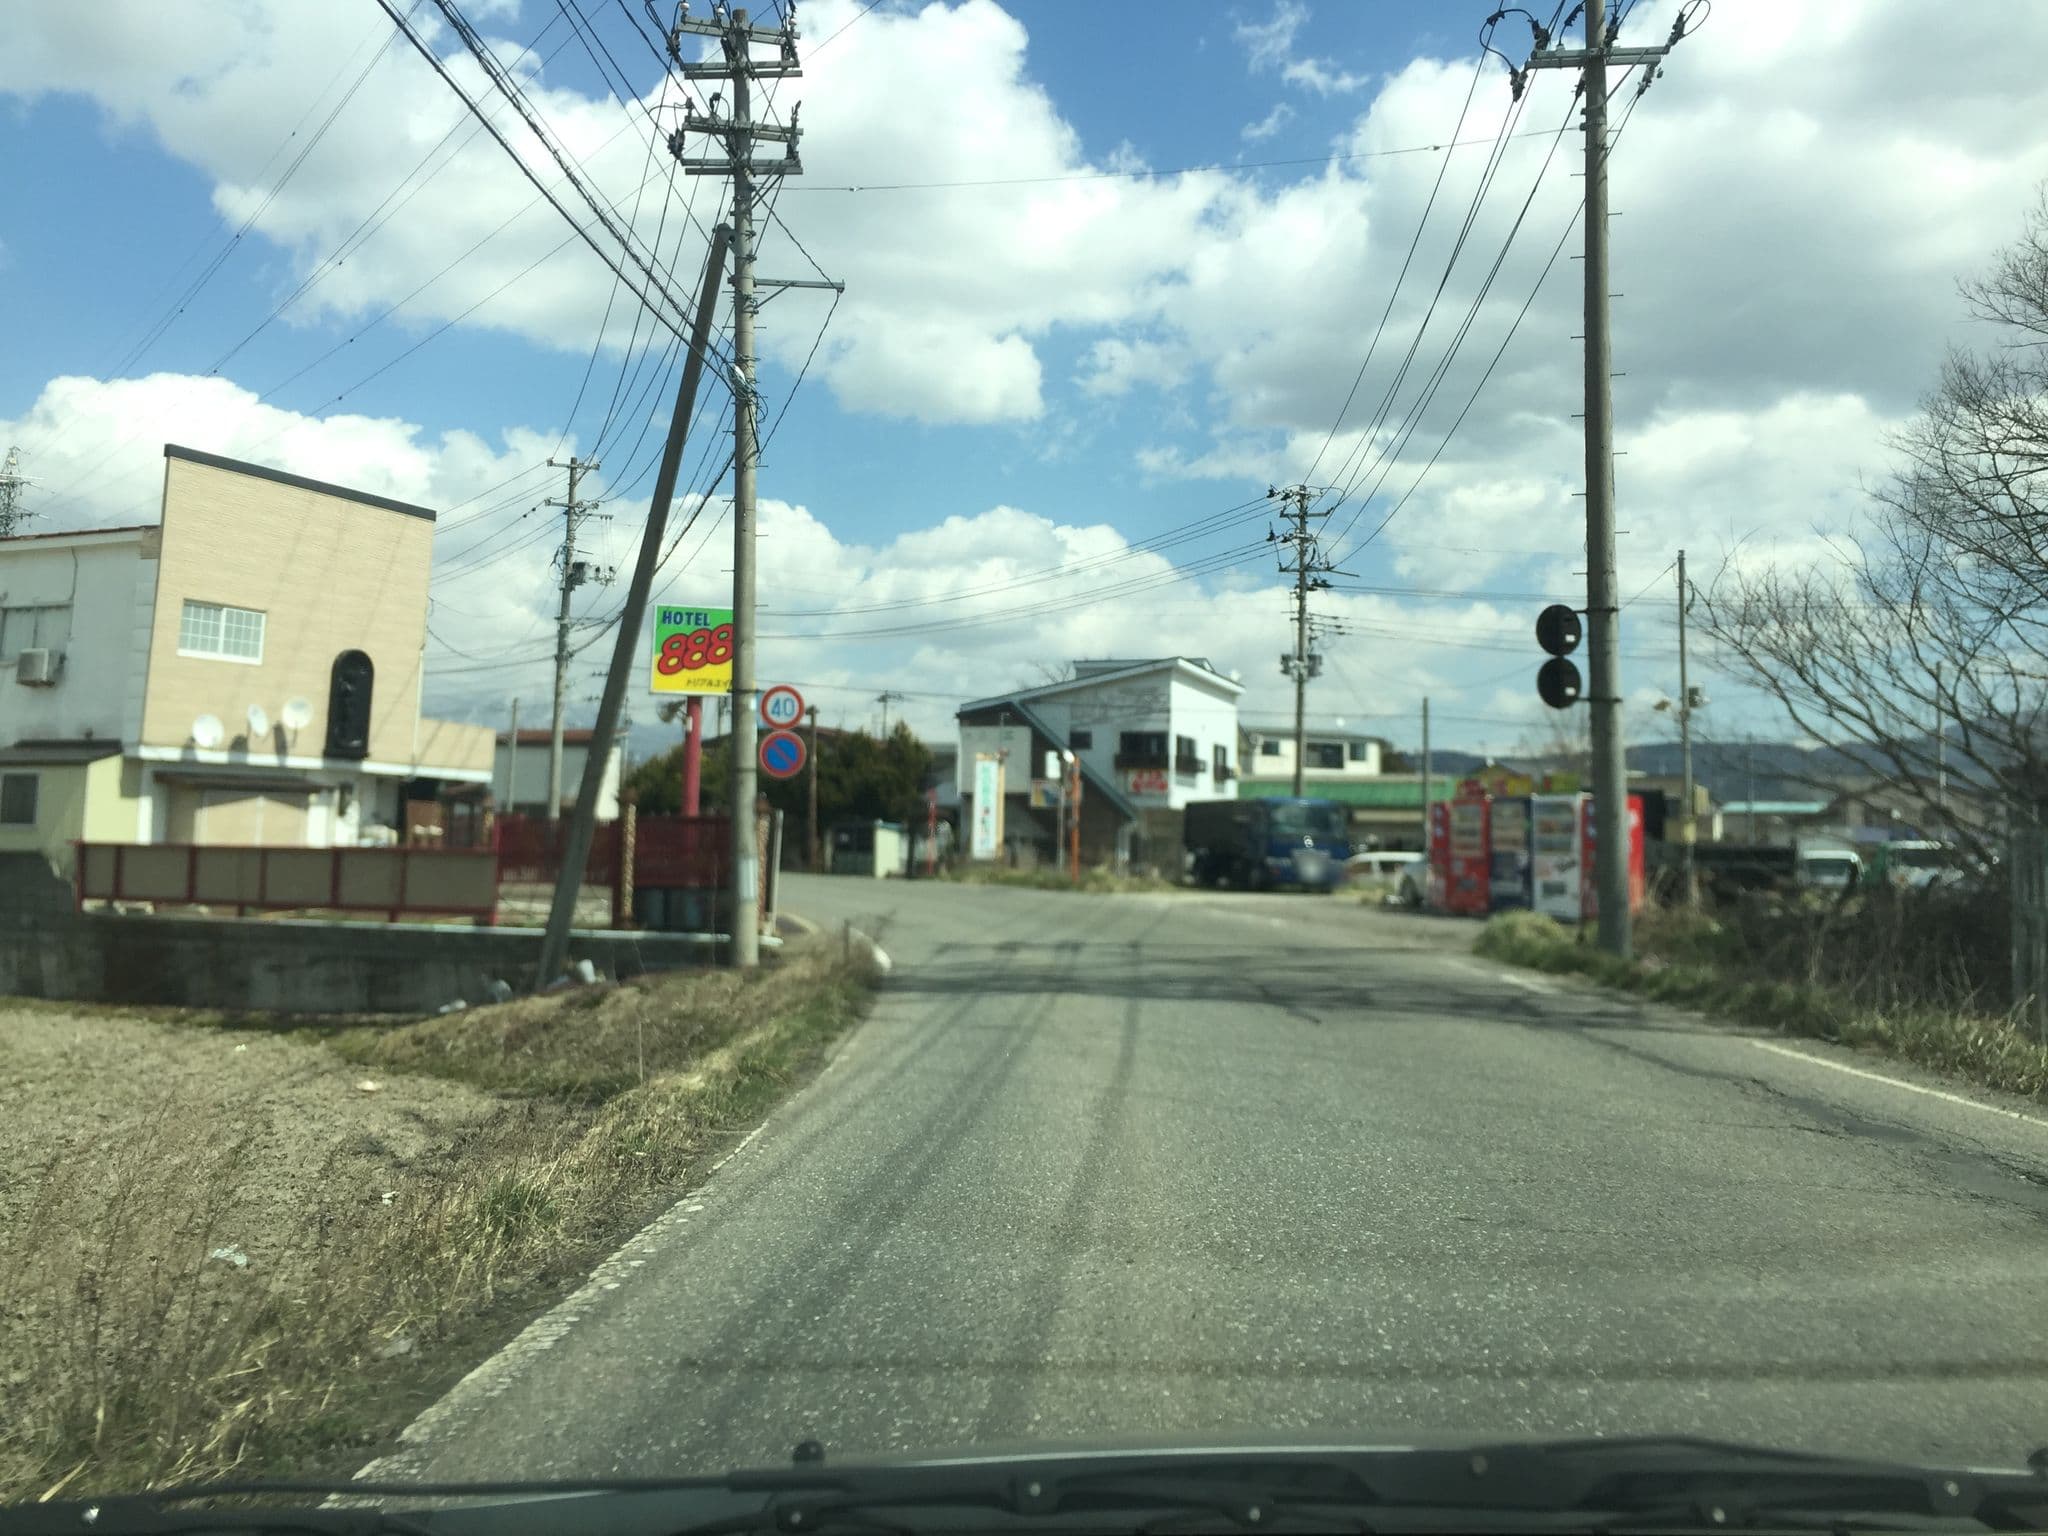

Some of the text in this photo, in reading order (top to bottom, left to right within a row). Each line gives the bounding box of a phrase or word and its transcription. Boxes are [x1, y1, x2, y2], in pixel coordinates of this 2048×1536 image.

[662, 610, 710, 626] HOTEL
[658, 623, 734, 675] 888
[771, 697, 795, 717] 40
